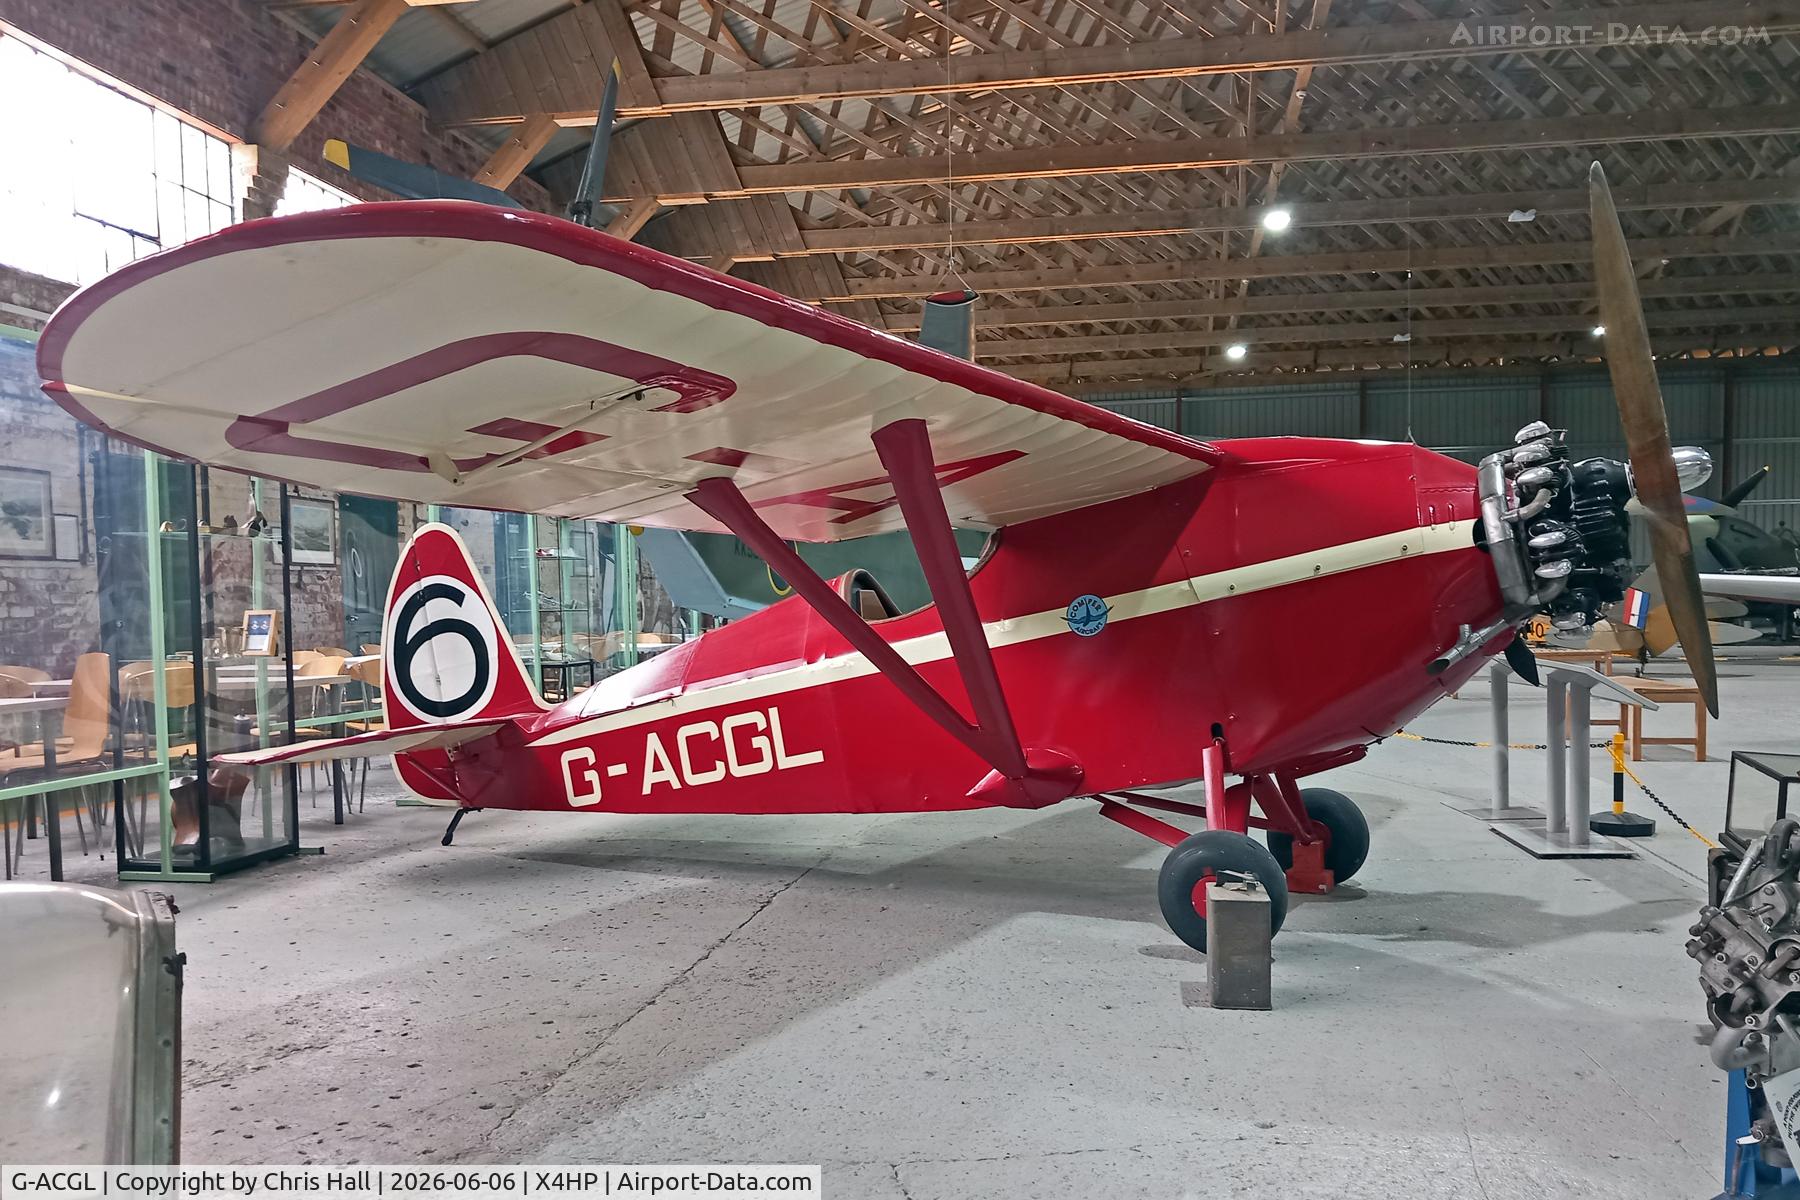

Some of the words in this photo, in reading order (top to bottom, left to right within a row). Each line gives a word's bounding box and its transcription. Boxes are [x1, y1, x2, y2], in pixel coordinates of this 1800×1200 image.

[1070, 598, 1102, 619] COMPER
[1074, 621, 1103, 635] AIRCRAFT
[393, 583, 490, 718] 6
[560, 706, 825, 808] G-ACGL
